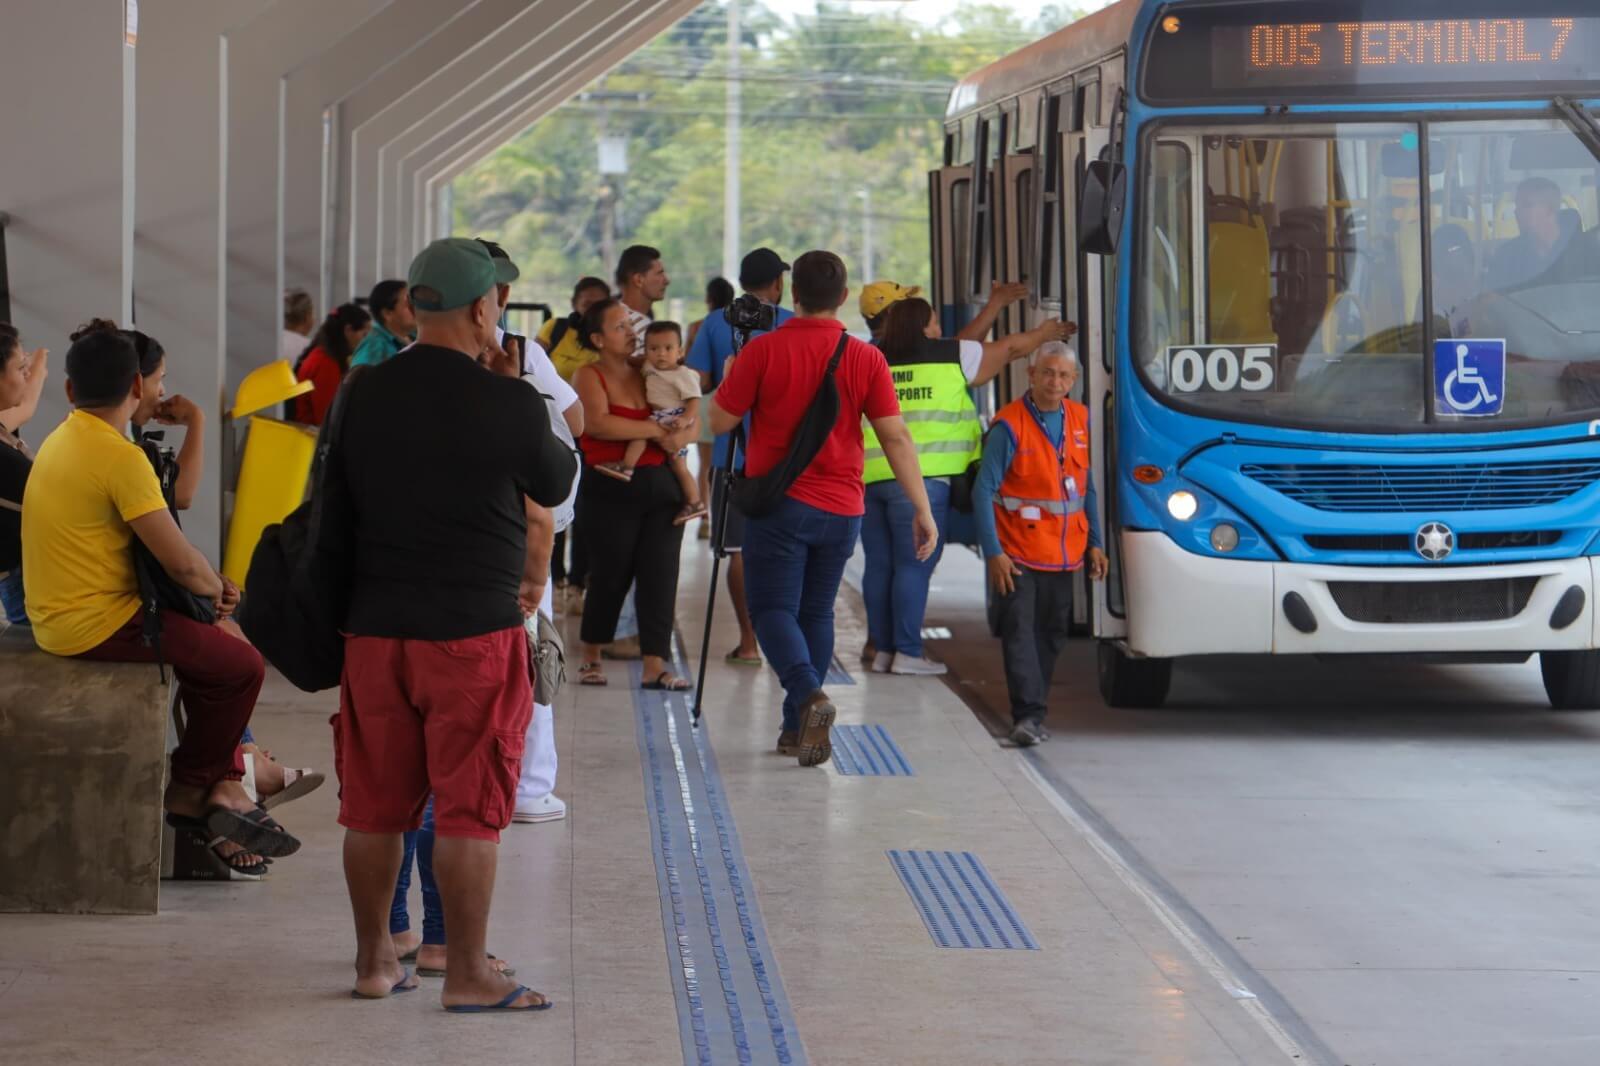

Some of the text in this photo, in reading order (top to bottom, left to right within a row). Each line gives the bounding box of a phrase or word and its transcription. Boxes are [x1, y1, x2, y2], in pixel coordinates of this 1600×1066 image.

[1251, 18, 1574, 67] 005 TERMINAL 7
[1171, 348, 1273, 392] 005
